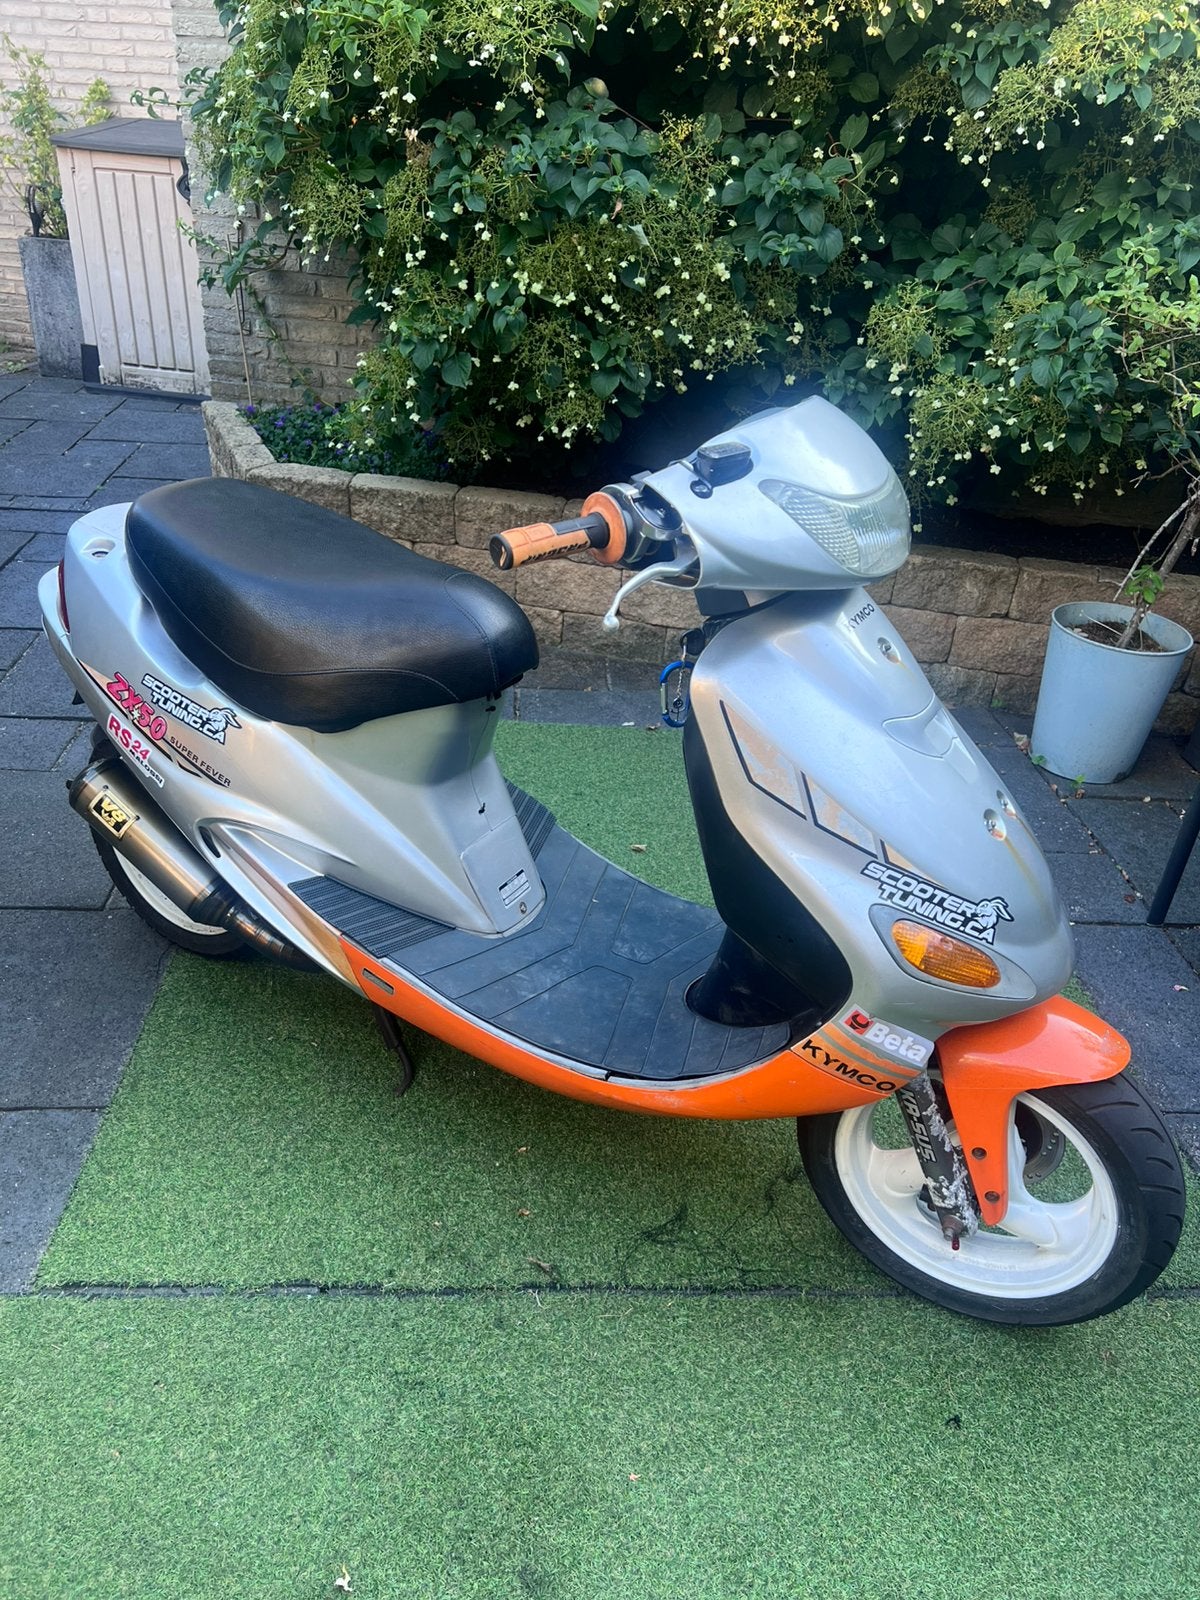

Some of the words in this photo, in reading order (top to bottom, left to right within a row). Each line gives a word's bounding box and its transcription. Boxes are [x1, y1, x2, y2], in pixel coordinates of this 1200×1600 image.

[142, 674, 210, 720] SCOOTER
[150, 692, 226, 744] TUNING.CA
[129, 748, 163, 784] MALOSSI
[170, 736, 199, 762] SUPER
[200, 760, 231, 787] FEVER
[863, 862, 979, 918] SCOOTER
[879, 883, 995, 944] TUNING.CA
[801, 1039, 897, 1092] KYMCO
[864, 1022, 927, 1062] Beta
